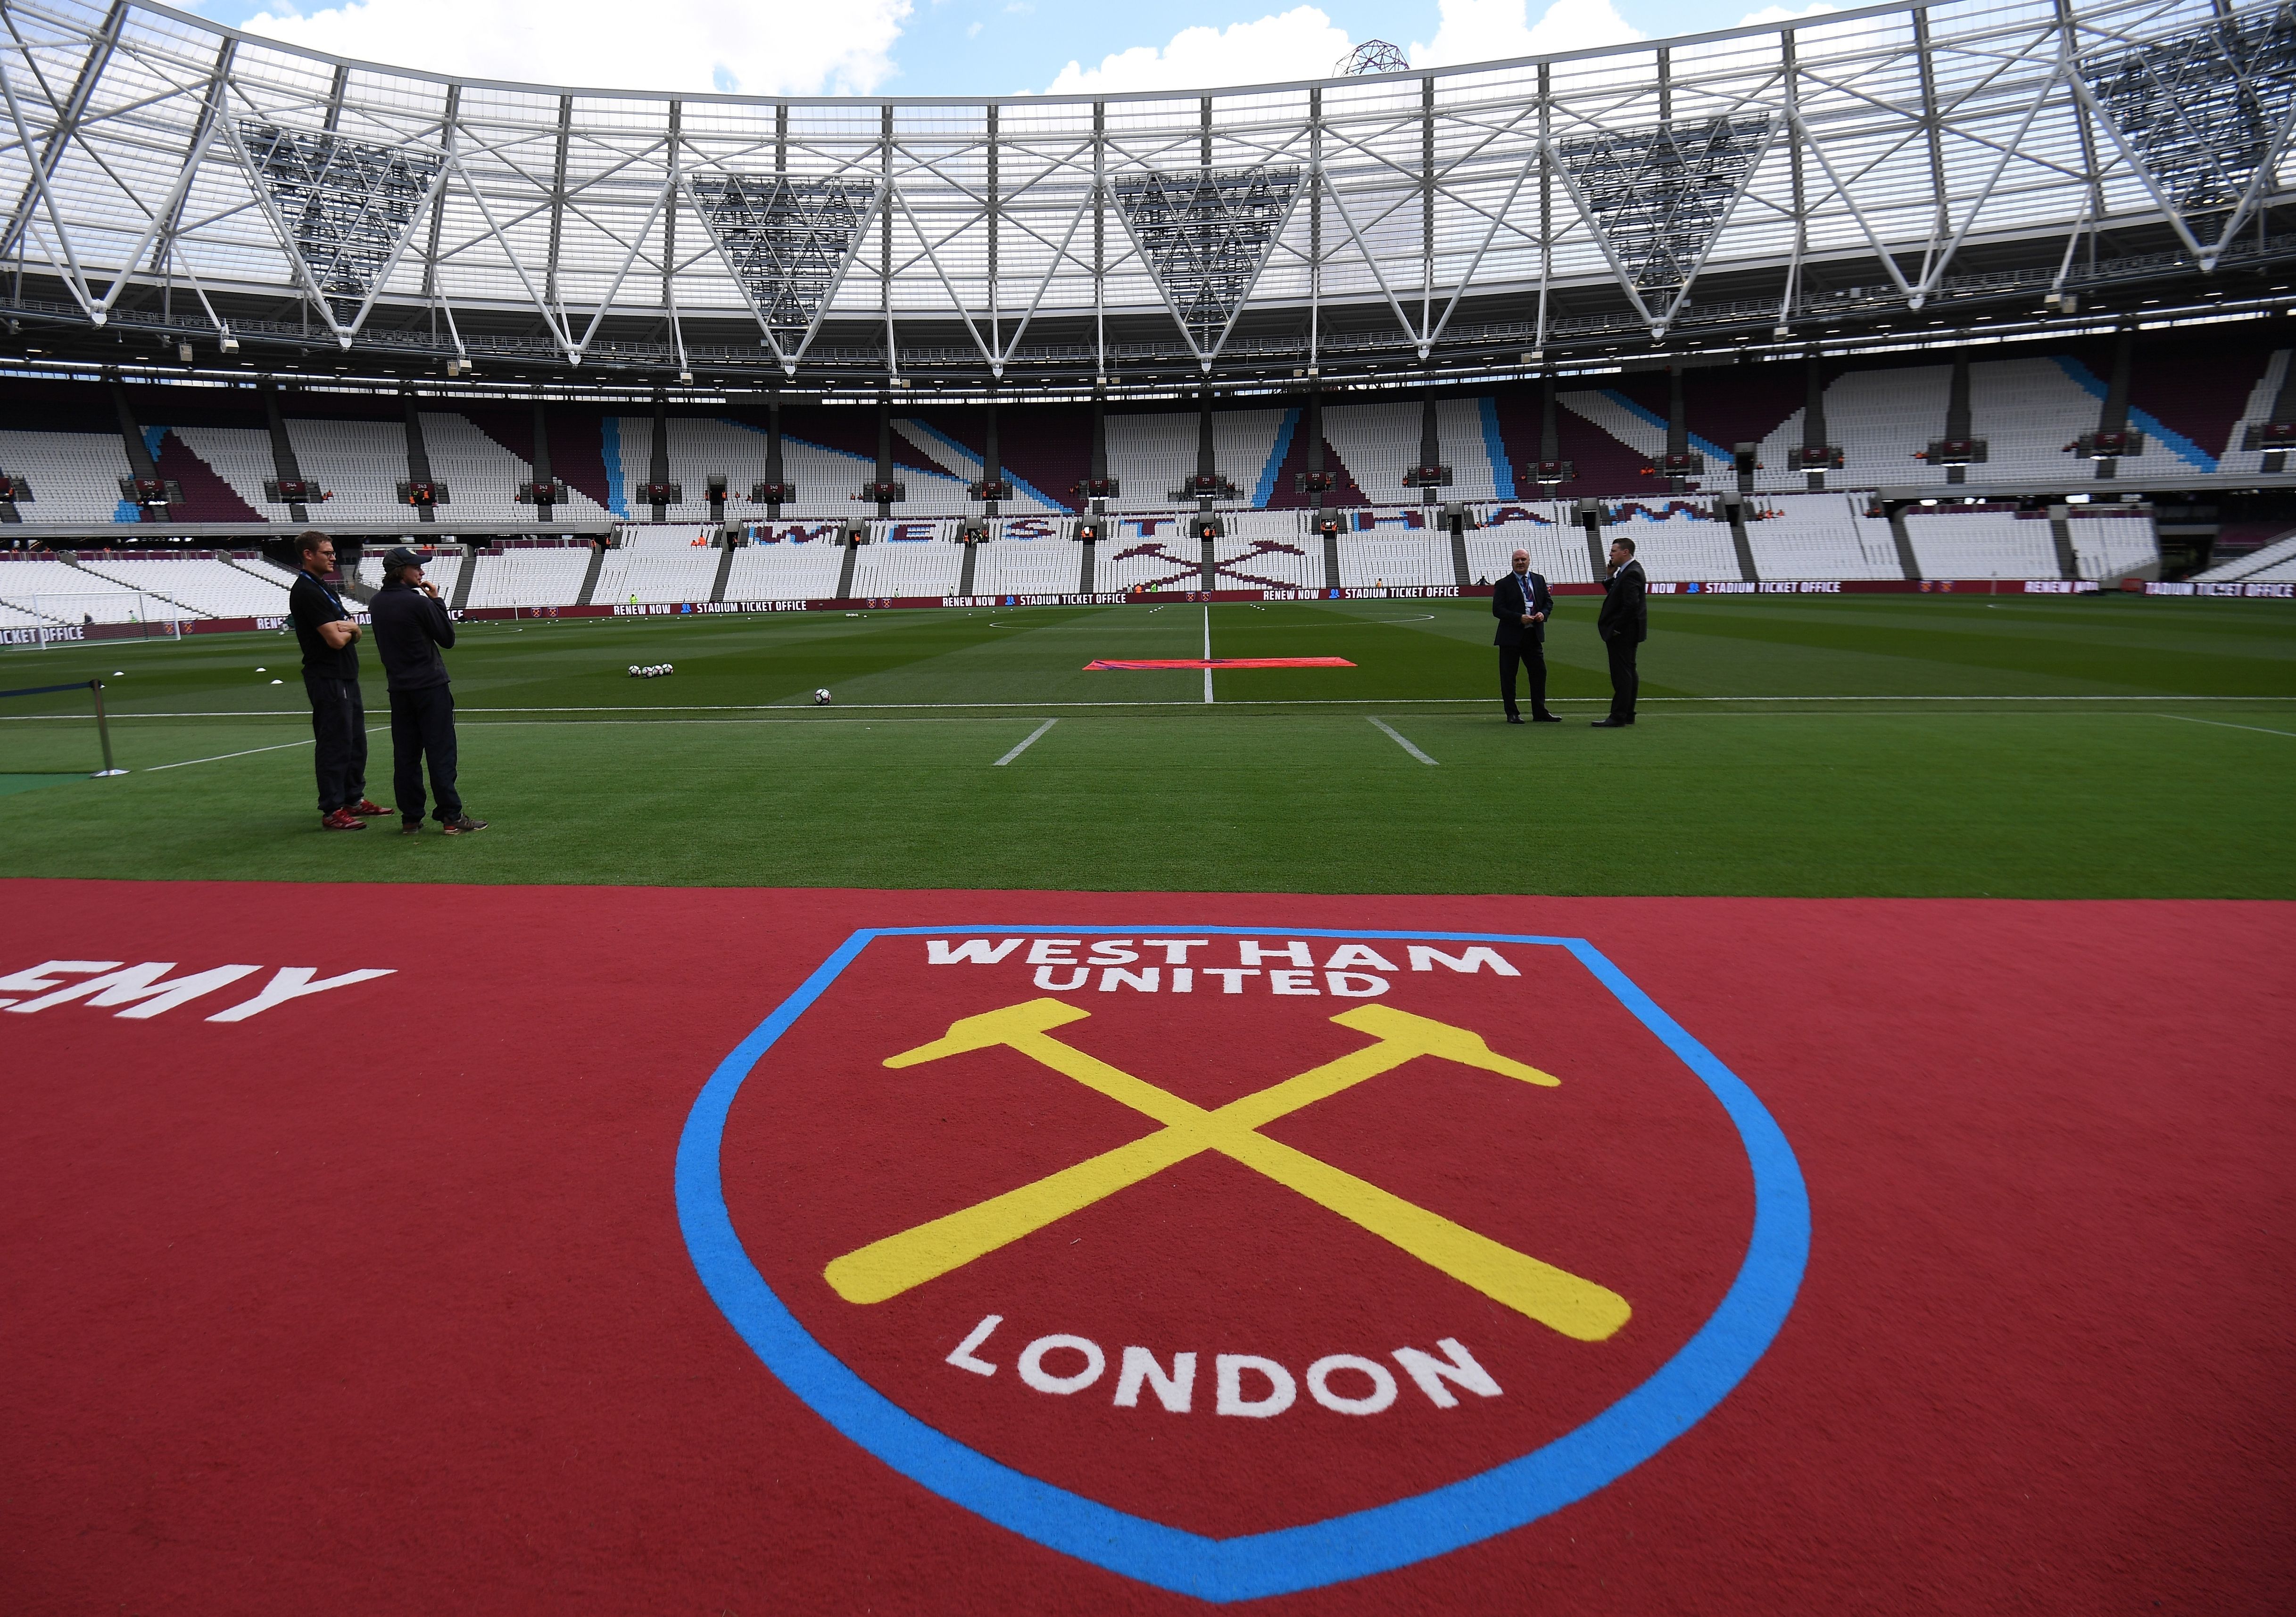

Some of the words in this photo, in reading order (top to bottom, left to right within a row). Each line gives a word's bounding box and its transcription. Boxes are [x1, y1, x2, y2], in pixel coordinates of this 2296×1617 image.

[1263, 590, 1295, 600] RENEW
[1298, 589, 1319, 600] NOW
[1345, 588, 1387, 598] STADIUM
[1390, 587, 1423, 597] TICKET
[1426, 586, 1459, 597] OFFICE
[1651, 583, 1676, 594] NOW
[1706, 582, 1755, 593] STADIUM
[1759, 582, 1798, 593] TICKET
[1801, 581, 1840, 593] OFFICE
[943, 597, 973, 607] RENEW
[976, 596, 995, 606] NOW
[1020, 595, 1059, 605] STADIUM
[1062, 594, 1093, 605] TICKET
[1096, 593, 1126, 604] OFFICE
[613, 605, 646, 615] RENEW
[649, 604, 671, 614] NOW
[696, 601, 738, 613] STADIUM
[740, 601, 772, 612] TICKET
[776, 600, 807, 611] OFFICE
[257, 617, 288, 630] RENE
[350, 614, 372, 624] TAD
[43, 627, 84, 642] OFFICE
[926, 938, 1209, 965] WEST
[1239, 940, 1522, 976] HAM
[1033, 965, 1390, 997] UNITED
[945, 1314, 1504, 1418] LONDON
